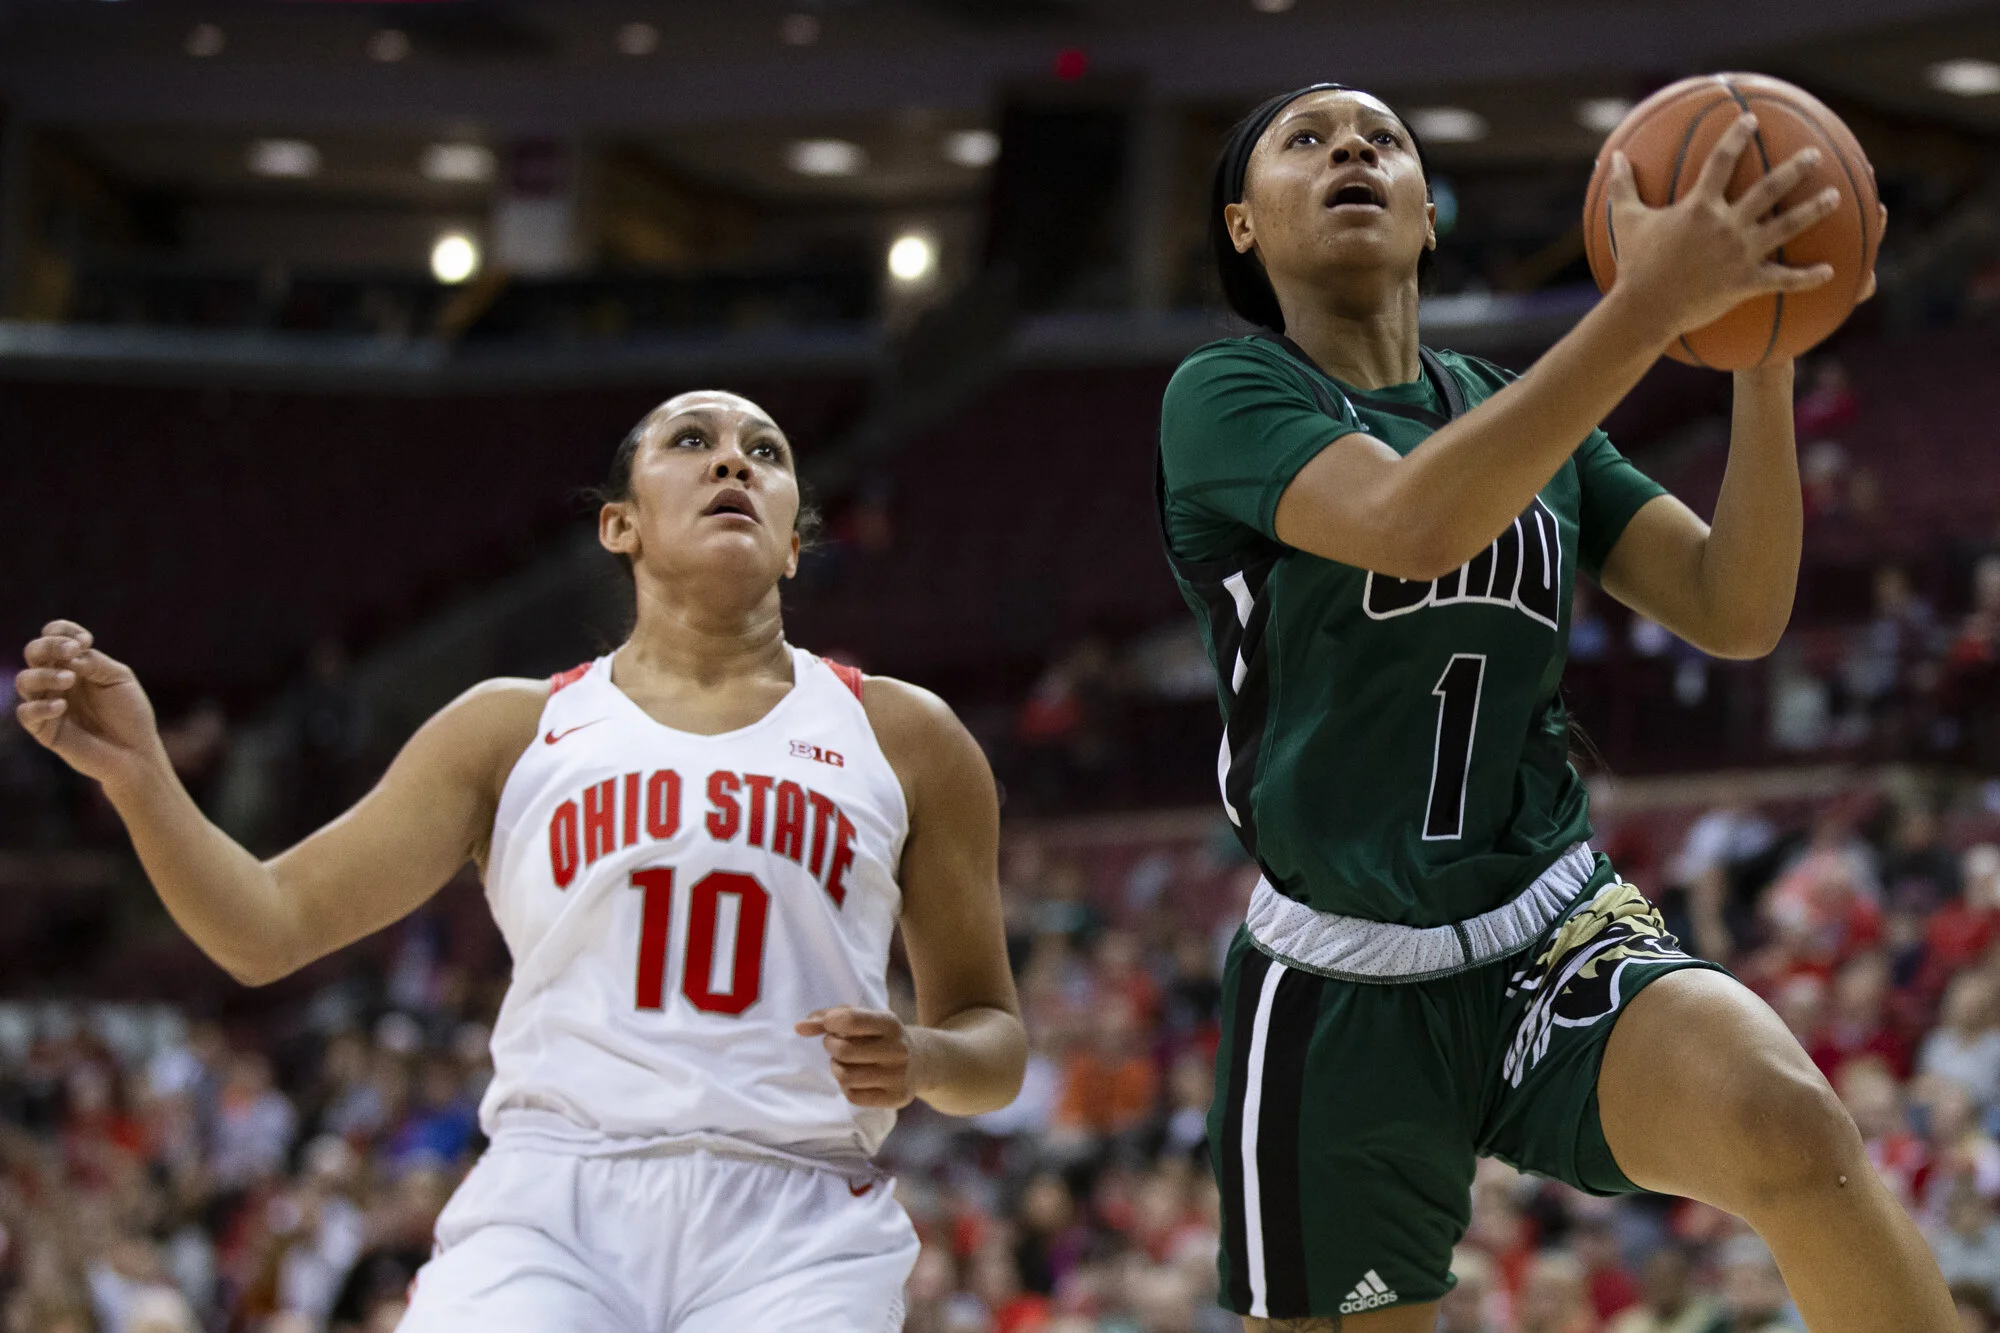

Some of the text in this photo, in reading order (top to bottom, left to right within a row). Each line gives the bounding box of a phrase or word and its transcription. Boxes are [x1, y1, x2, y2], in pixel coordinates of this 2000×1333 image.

[1422, 653, 1486, 840] 1
[549, 768, 857, 911] OHIO STATE
[628, 866, 772, 1018] 10
[1339, 1290, 1398, 1314] adidas
